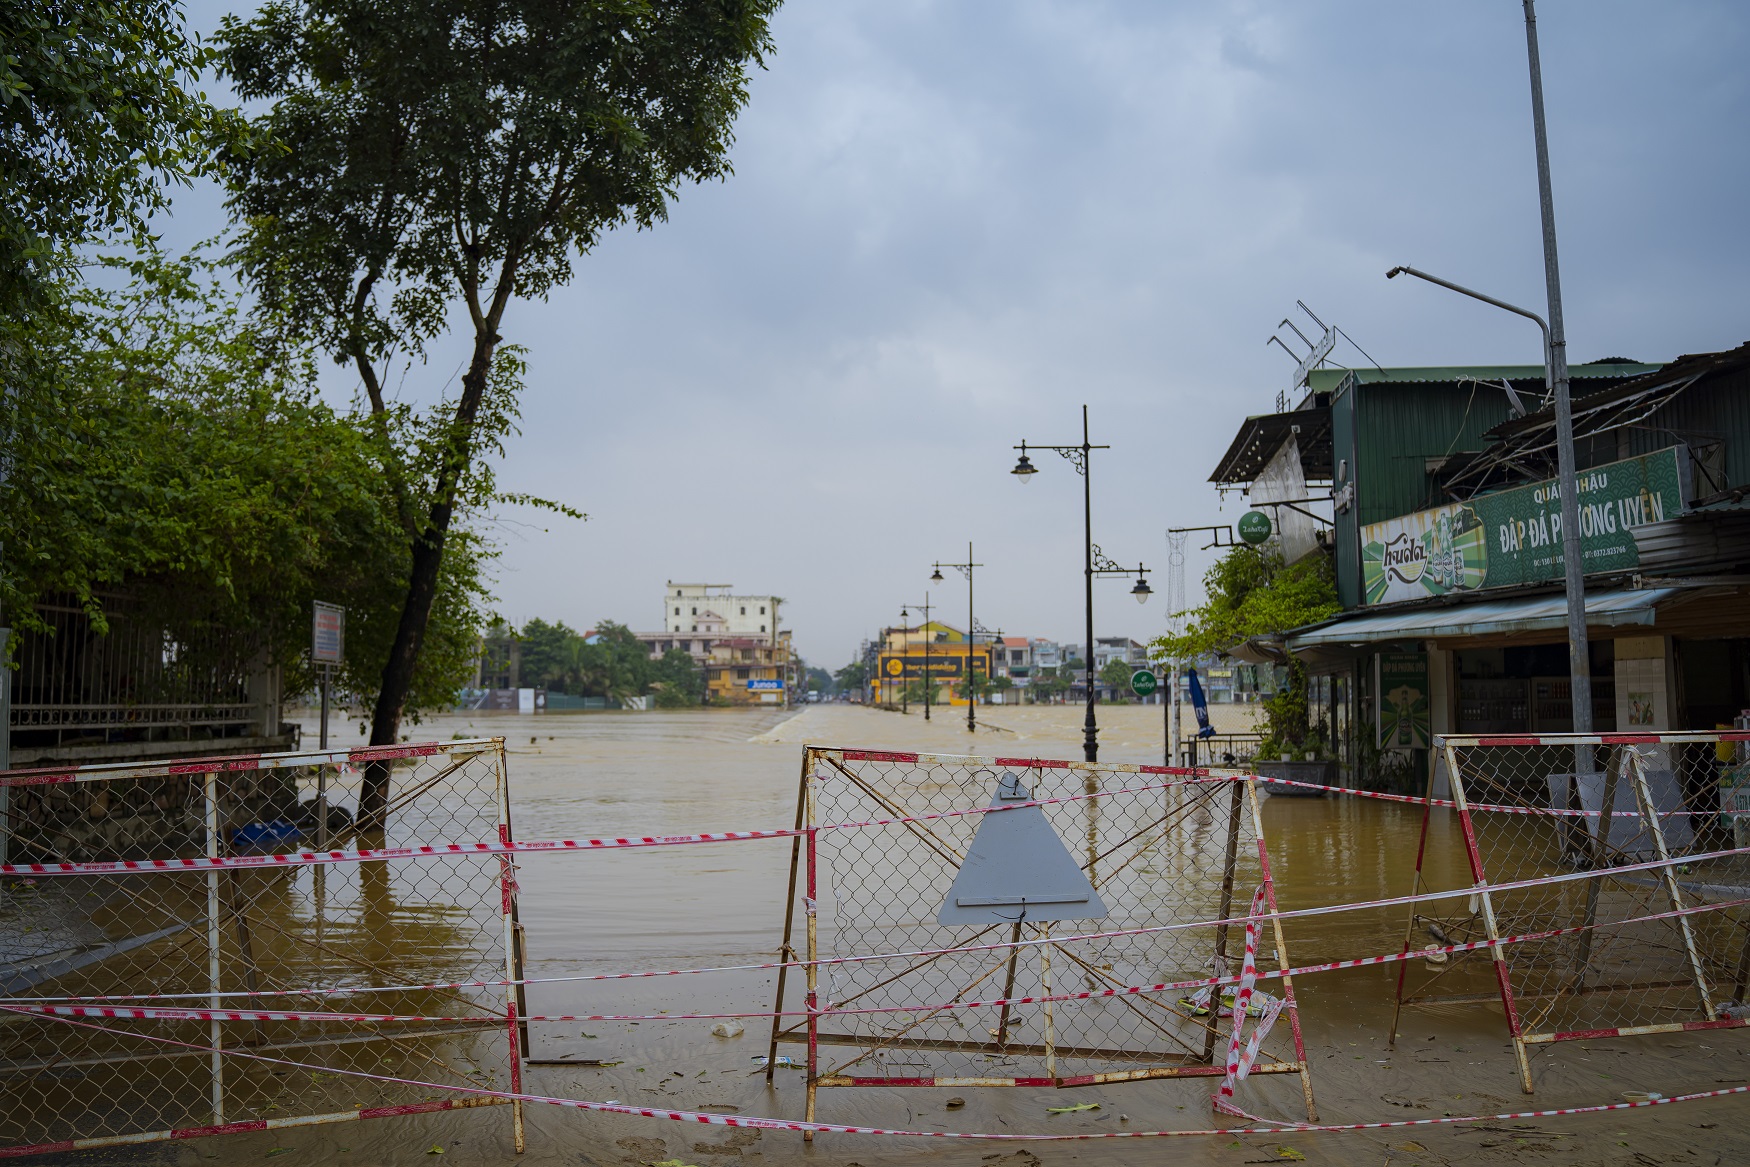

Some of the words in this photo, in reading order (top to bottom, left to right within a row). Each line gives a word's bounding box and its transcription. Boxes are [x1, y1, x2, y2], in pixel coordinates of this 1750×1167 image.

[1534, 483, 1562, 504] QUÁ
[1499, 516, 1526, 559] ĐẬP
[1529, 510, 1550, 548] ĐÁ
[1550, 501, 1616, 544] PƠNG
[1618, 488, 1664, 531] UYÊN
